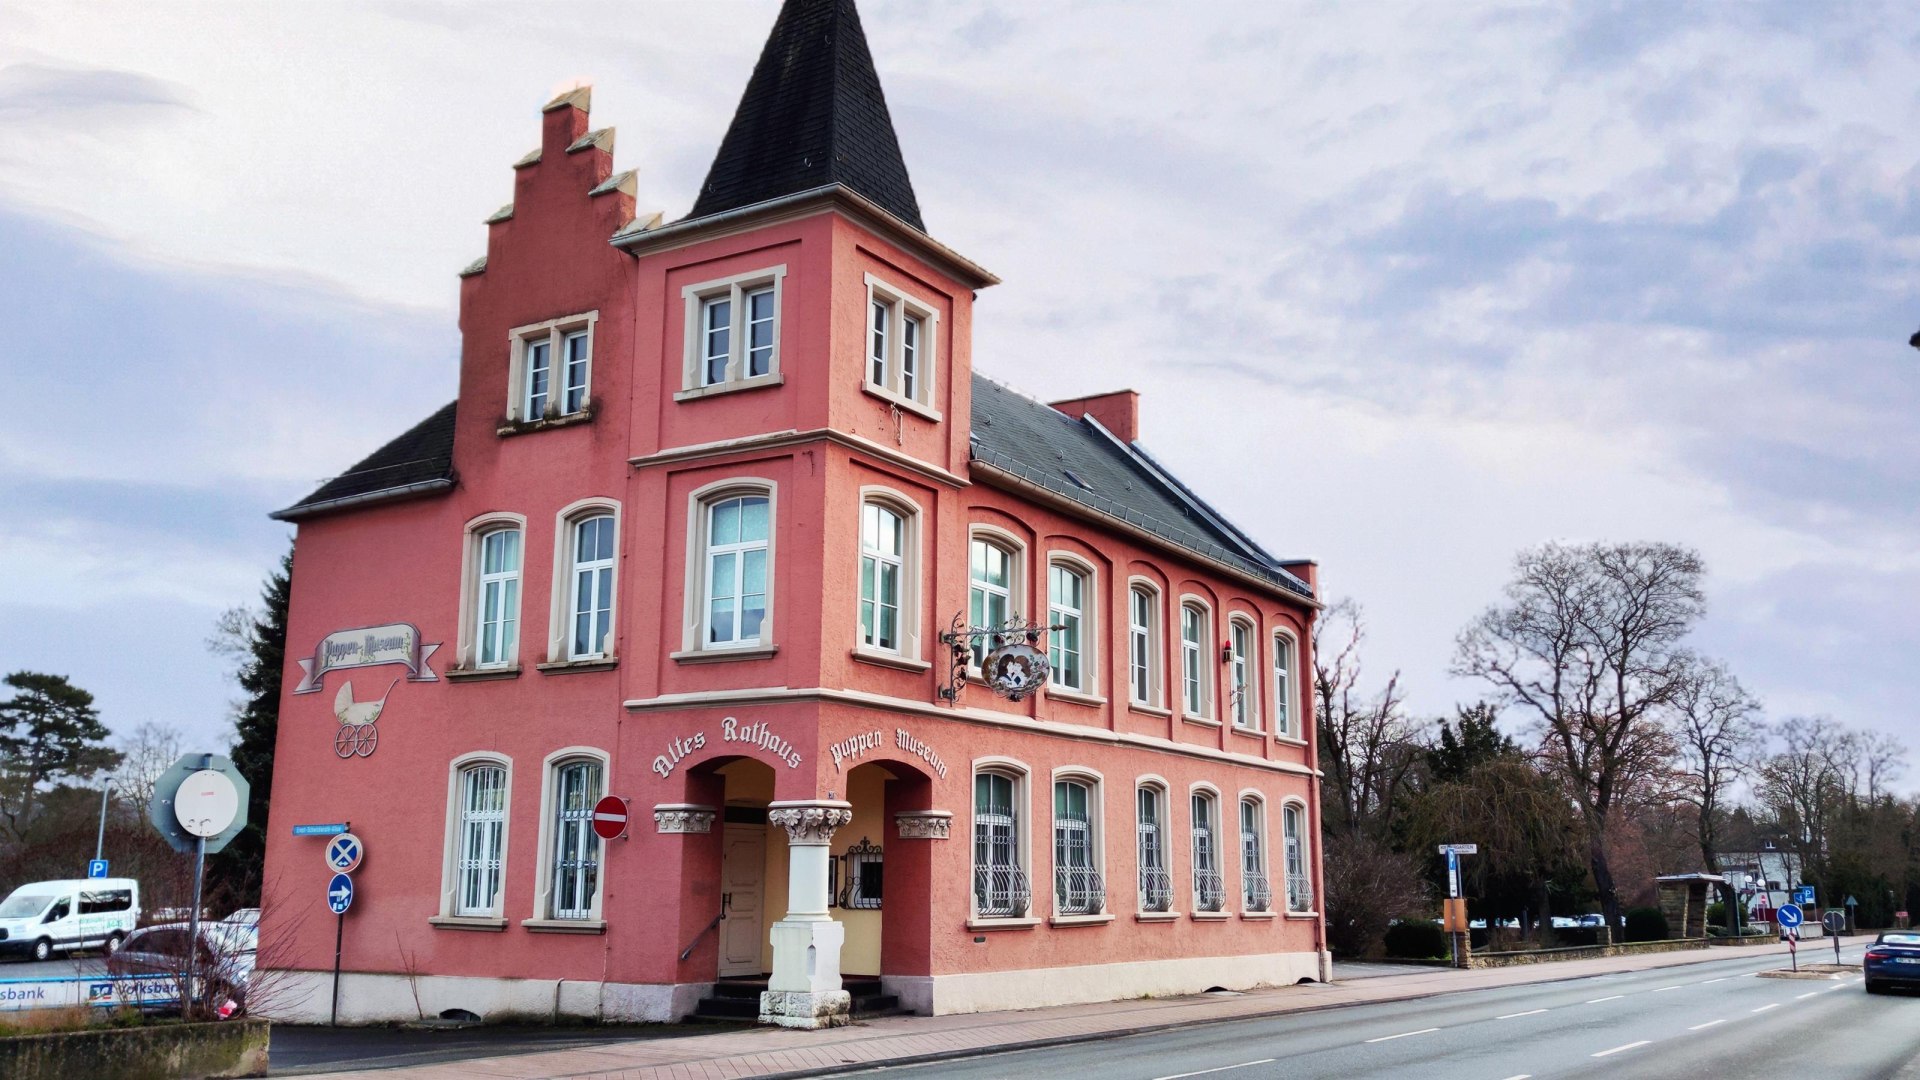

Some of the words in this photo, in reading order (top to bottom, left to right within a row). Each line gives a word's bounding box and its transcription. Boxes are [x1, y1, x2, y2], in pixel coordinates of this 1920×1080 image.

[652, 731, 706, 779] Altes
[721, 716, 803, 769] Rathaus
[896, 727, 947, 779] Museum
[93, 862, 104, 877] P
